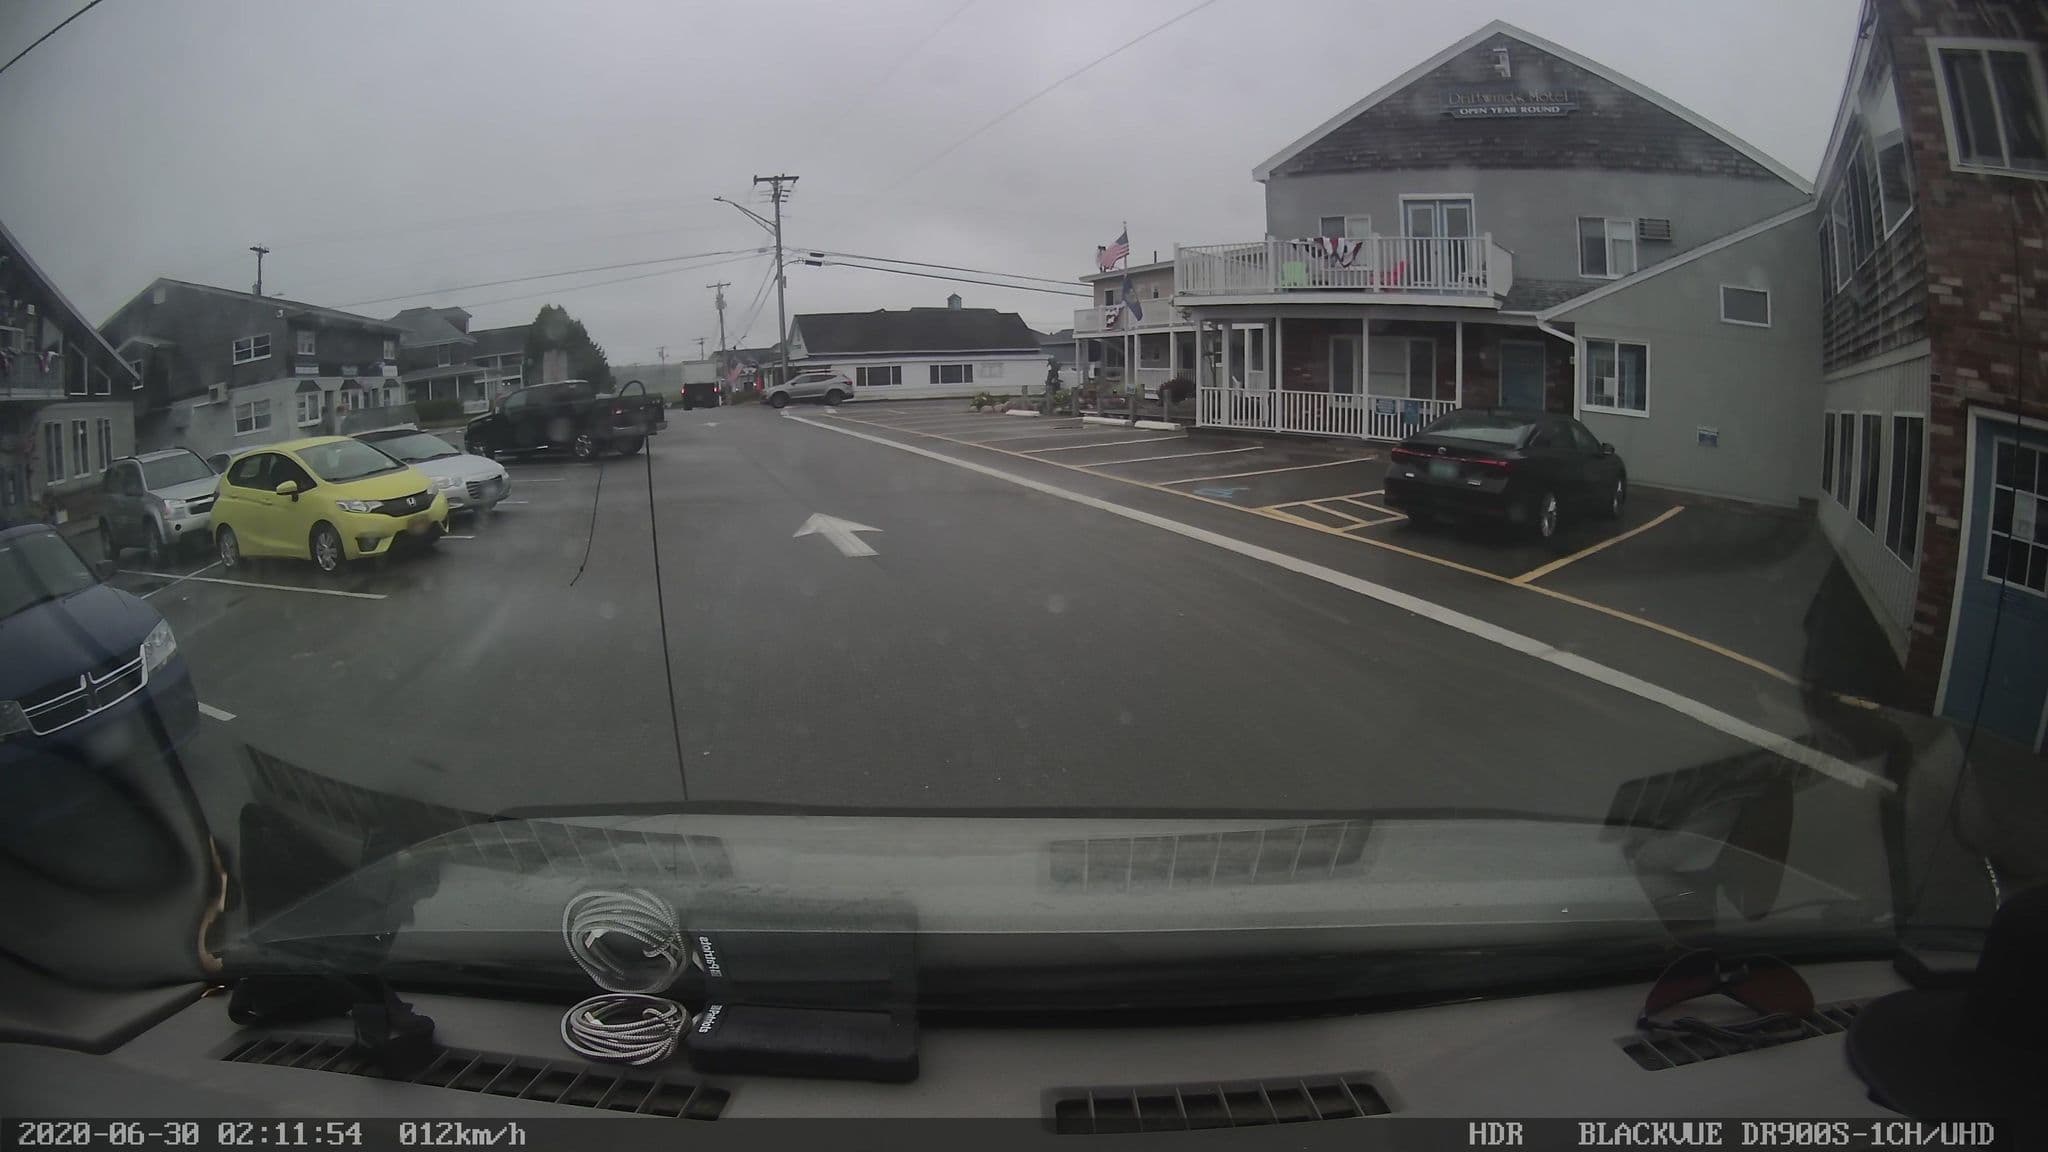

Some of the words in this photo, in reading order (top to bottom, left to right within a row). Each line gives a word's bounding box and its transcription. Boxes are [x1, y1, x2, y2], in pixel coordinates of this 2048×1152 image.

[1460, 107, 1488, 115] OPEN
[1490, 107, 1517, 115] YEAR
[1520, 106, 1560, 114] ROUND
